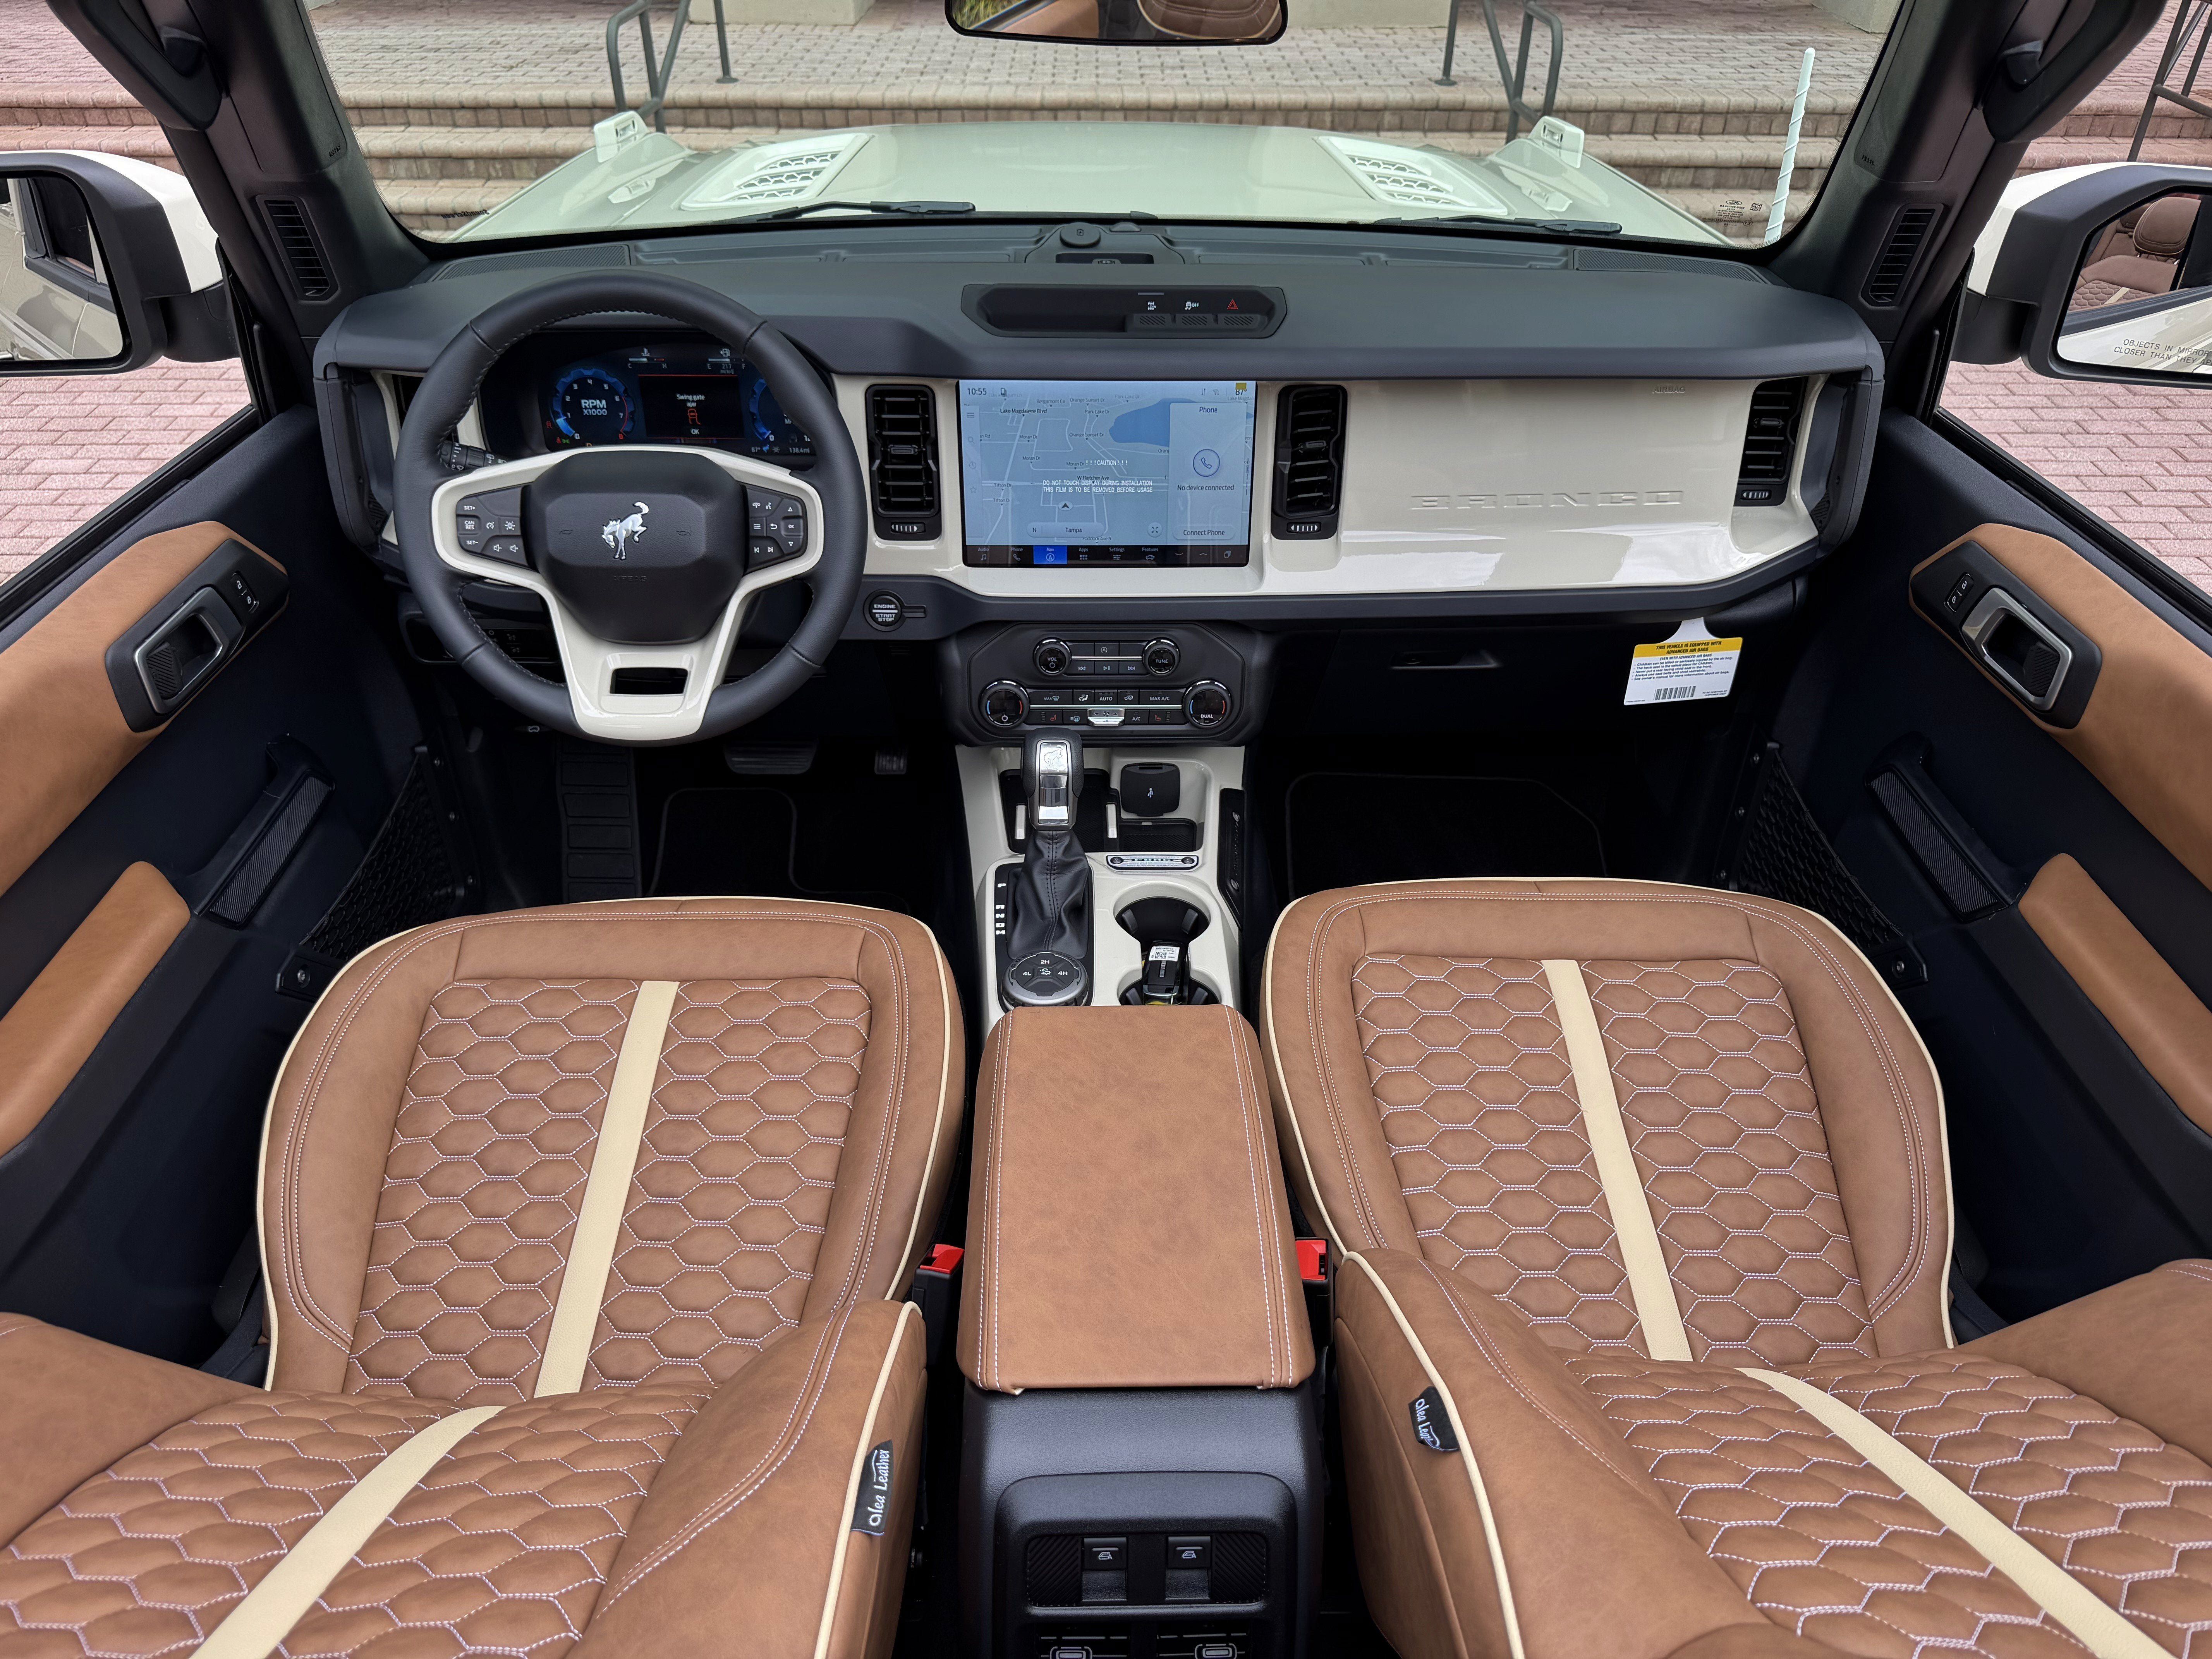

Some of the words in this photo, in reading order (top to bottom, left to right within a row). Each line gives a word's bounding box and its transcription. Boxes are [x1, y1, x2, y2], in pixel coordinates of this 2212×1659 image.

[2114, 346, 2146, 357] CLOSER
[2151, 352, 2172, 360] THAN
[2177, 356, 2197, 364] THEY
[2123, 339, 2160, 350] OBJECTS
[2178, 347, 2210, 357] MIRROR
[1652, 386, 1686, 394] AIRBAG
[581, 399, 606, 409] RPM
[1409, 490, 1684, 511] BRONCO
[874, 1449, 890, 1491] Leather
